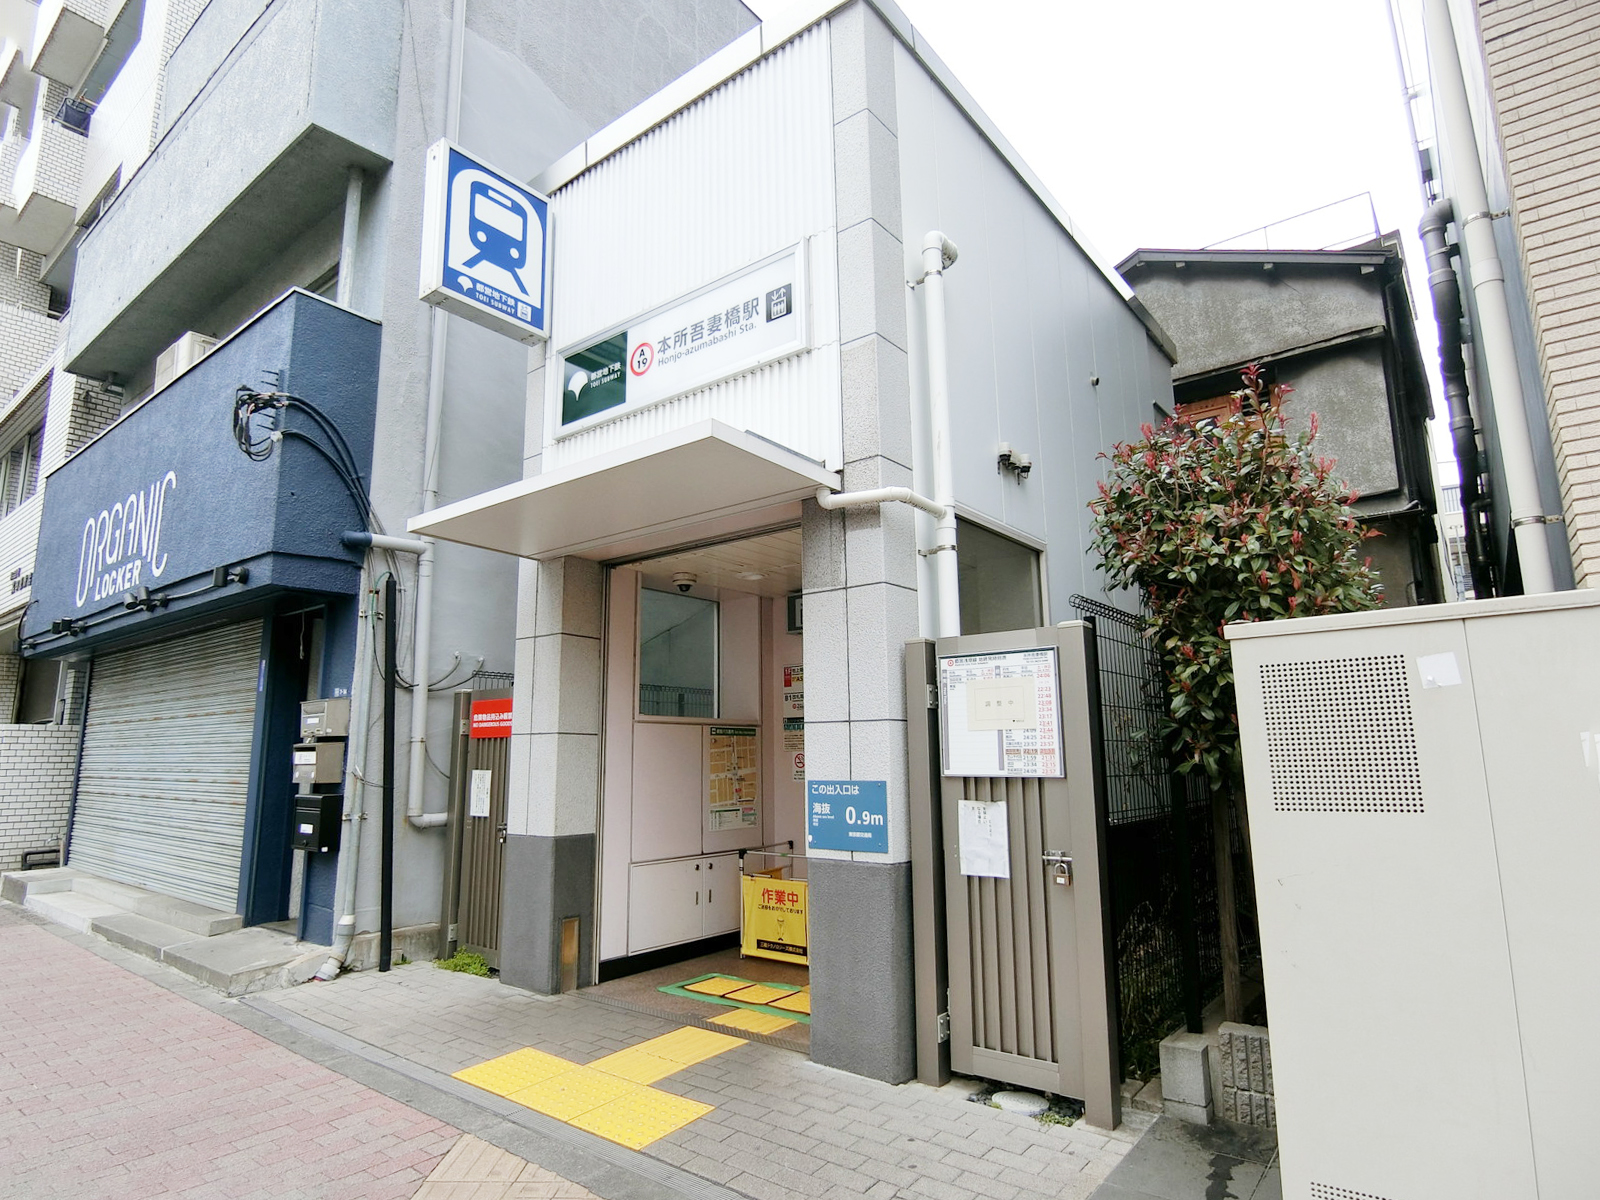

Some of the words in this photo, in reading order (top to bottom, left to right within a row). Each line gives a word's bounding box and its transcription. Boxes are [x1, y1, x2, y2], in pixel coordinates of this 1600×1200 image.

[475, 292, 490, 303] TOEI
[491, 299, 516, 314] SUBWAY
[476, 283, 516, 307] 都営地下鉄
[657, 297, 759, 355] 本所吾妻橋駅
[639, 348, 646, 359] A
[658, 327, 738, 367] Honjo-azumabashi
[740, 322, 757, 335] Sta.
[590, 361, 622, 381] 都営地下鉄
[637, 357, 648, 369] 19
[590, 379, 601, 389] TOEI
[601, 371, 622, 385] SUBWAY
[76, 470, 177, 608] ORGANIC
[94, 559, 142, 601] LOCKER
[811, 784, 860, 795] この出入口は
[812, 802, 831, 814] 海抜
[845, 806, 884, 826] 0.9m
[761, 887, 799, 908] 作業中
